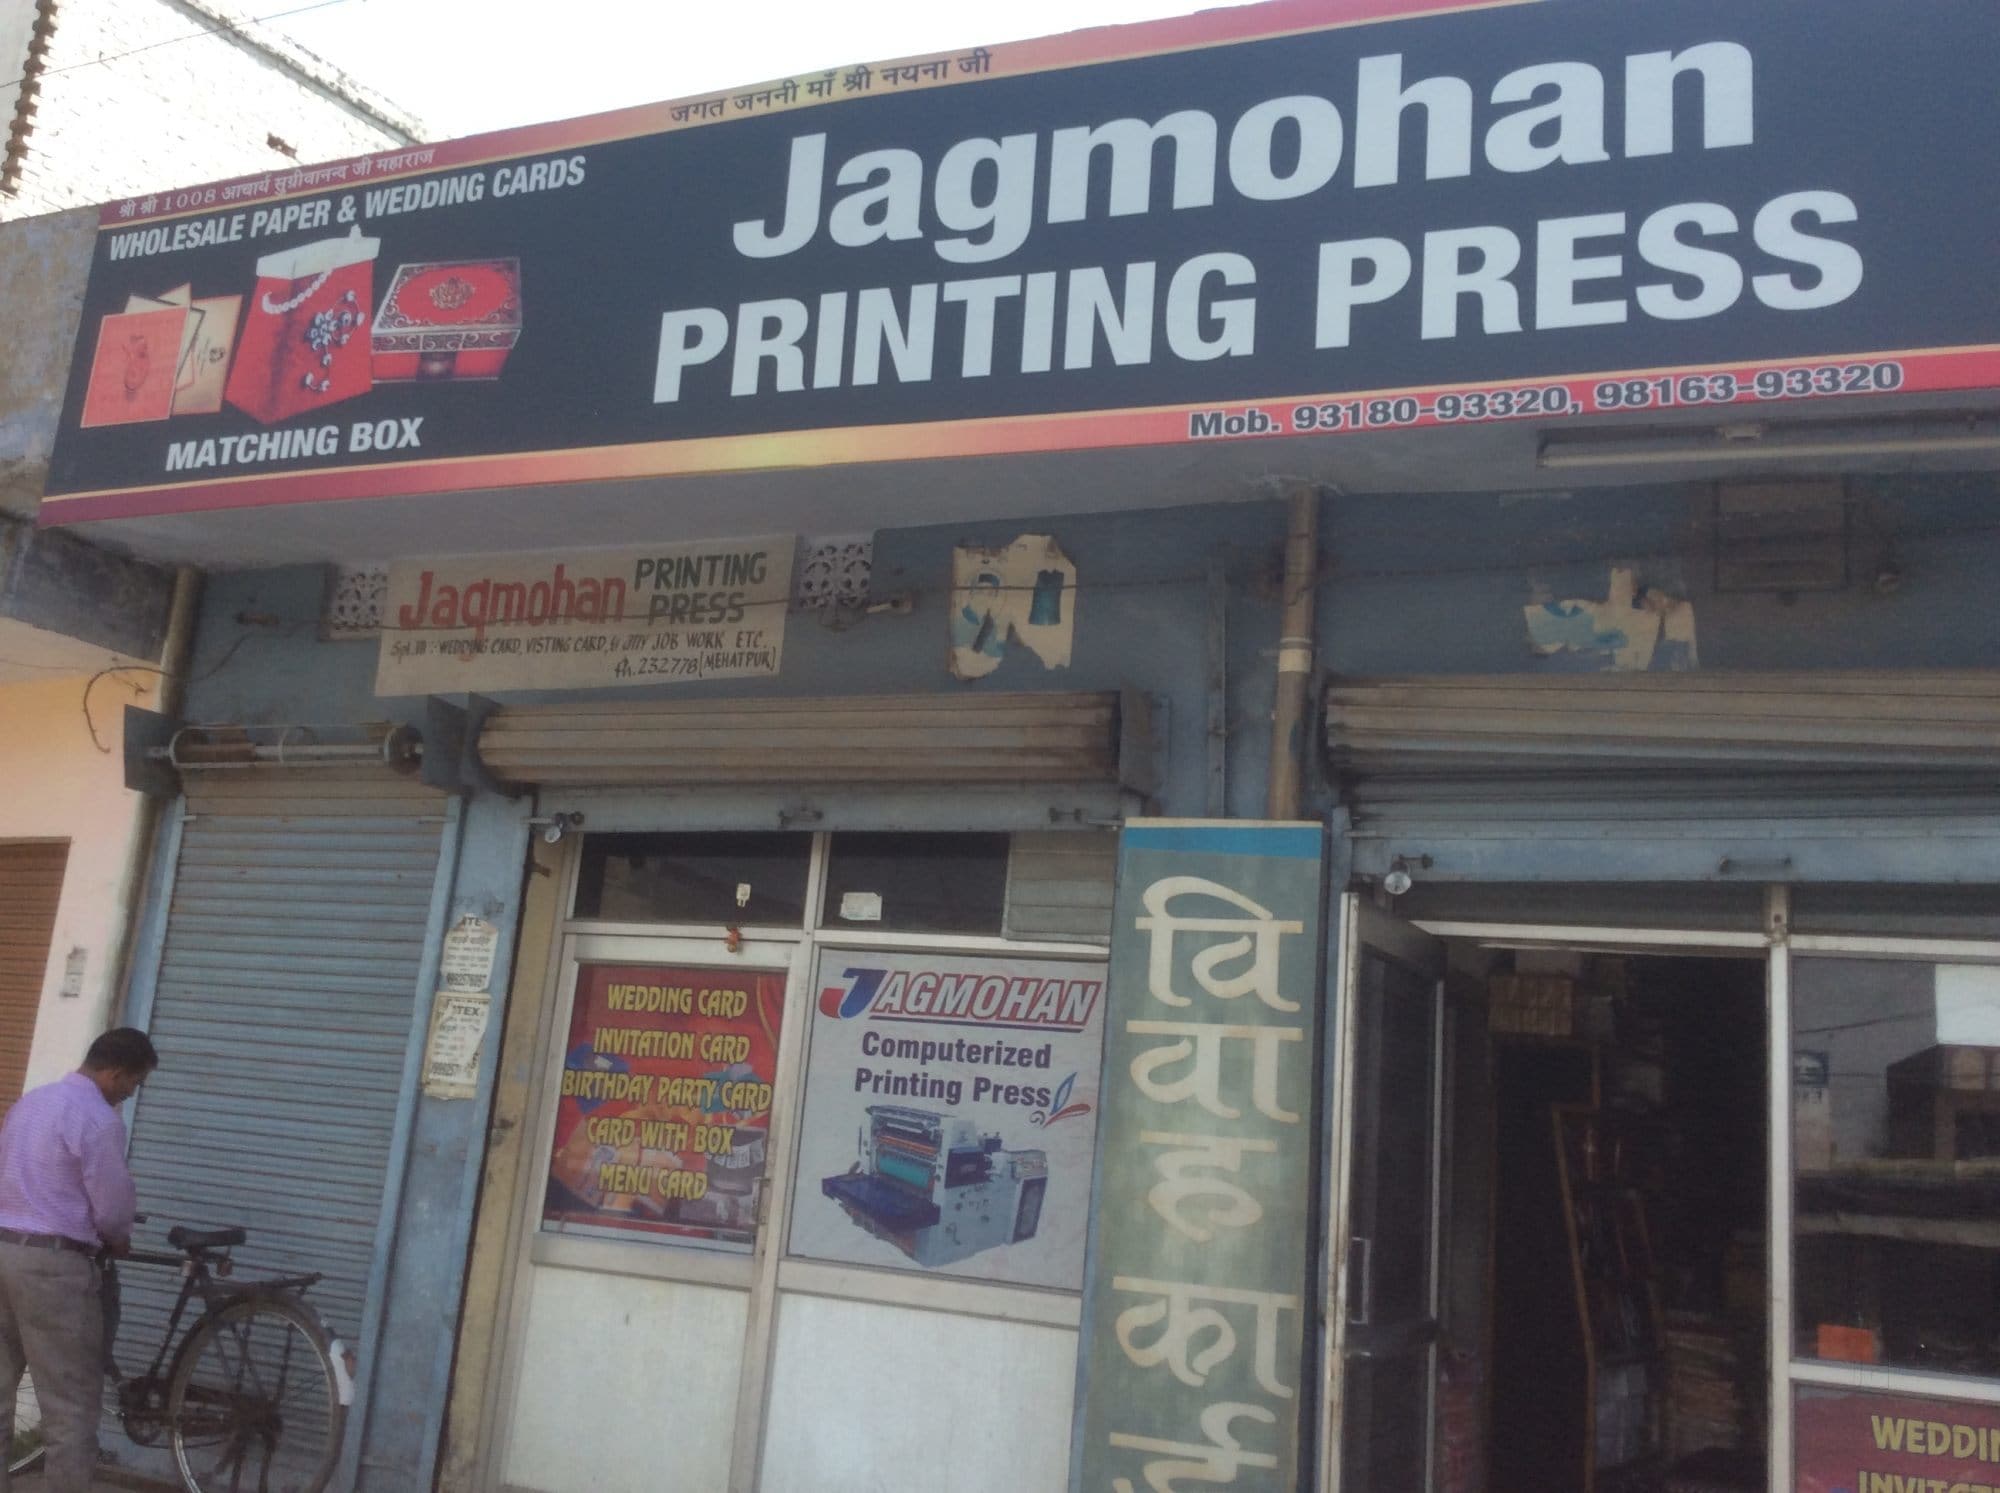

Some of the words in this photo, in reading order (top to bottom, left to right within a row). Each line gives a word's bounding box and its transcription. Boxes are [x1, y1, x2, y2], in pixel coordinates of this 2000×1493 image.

[670, 97, 727, 123] जगत
[733, 79, 802, 111] जननी
[806, 71, 835, 98] माँ
[842, 65, 874, 92] श्री
[880, 59, 952, 86] नयना
[957, 47, 993, 73] जी
[733, 41, 1753, 264] Jagmohan
[119, 200, 135, 218] श्री
[140, 196, 157, 215] श्री
[163, 188, 216, 212] 1008
[222, 174, 269, 201] आचार्य
[352, 157, 373, 177] जी
[376, 150, 436, 172] महाराज
[110, 214, 246, 261] WHOLESALE
[250, 199, 330, 239] PAPER
[337, 195, 357, 224] &
[365, 172, 485, 219] WEDDING
[492, 155, 587, 198] CARDS
[653, 252, 1257, 405] PRINTING
[1314, 190, 1864, 350] PRESS
[1190, 409, 1280, 437] Mob.
[1294, 386, 1582, 431] 93180-93320,
[1595, 361, 1903, 409] 98163-93320
[165, 425, 339, 471] MATCHING
[348, 417, 424, 452] BOX
[399, 563, 626, 660] Jagmohan
[634, 551, 767, 592] PRINTING
[648, 591, 745, 626] PRESS
[652, 632, 679, 650] JOB
[686, 630, 723, 649] WORK
[607, 983, 693, 1014] WEDDING
[698, 989, 748, 1019] CARD
[819, 968, 1103, 1026] JAGMOHAN
[593, 1027, 695, 1059] INVITATION
[700, 1034, 750, 1063] CARD
[863, 1031, 1051, 1068] Computerized
[561, 1070, 654, 1103] BIRTHDAY
[657, 1075, 717, 1109] PARTY
[721, 1081, 773, 1111] CARD
[854, 1067, 962, 1105] Printing
[973, 1076, 1051, 1107] Press
[587, 1117, 636, 1147] CARD
[641, 1120, 689, 1152] WITH
[694, 1125, 736, 1154] BOX
[599, 1164, 652, 1194] MENU
[657, 1169, 708, 1200] CARD
